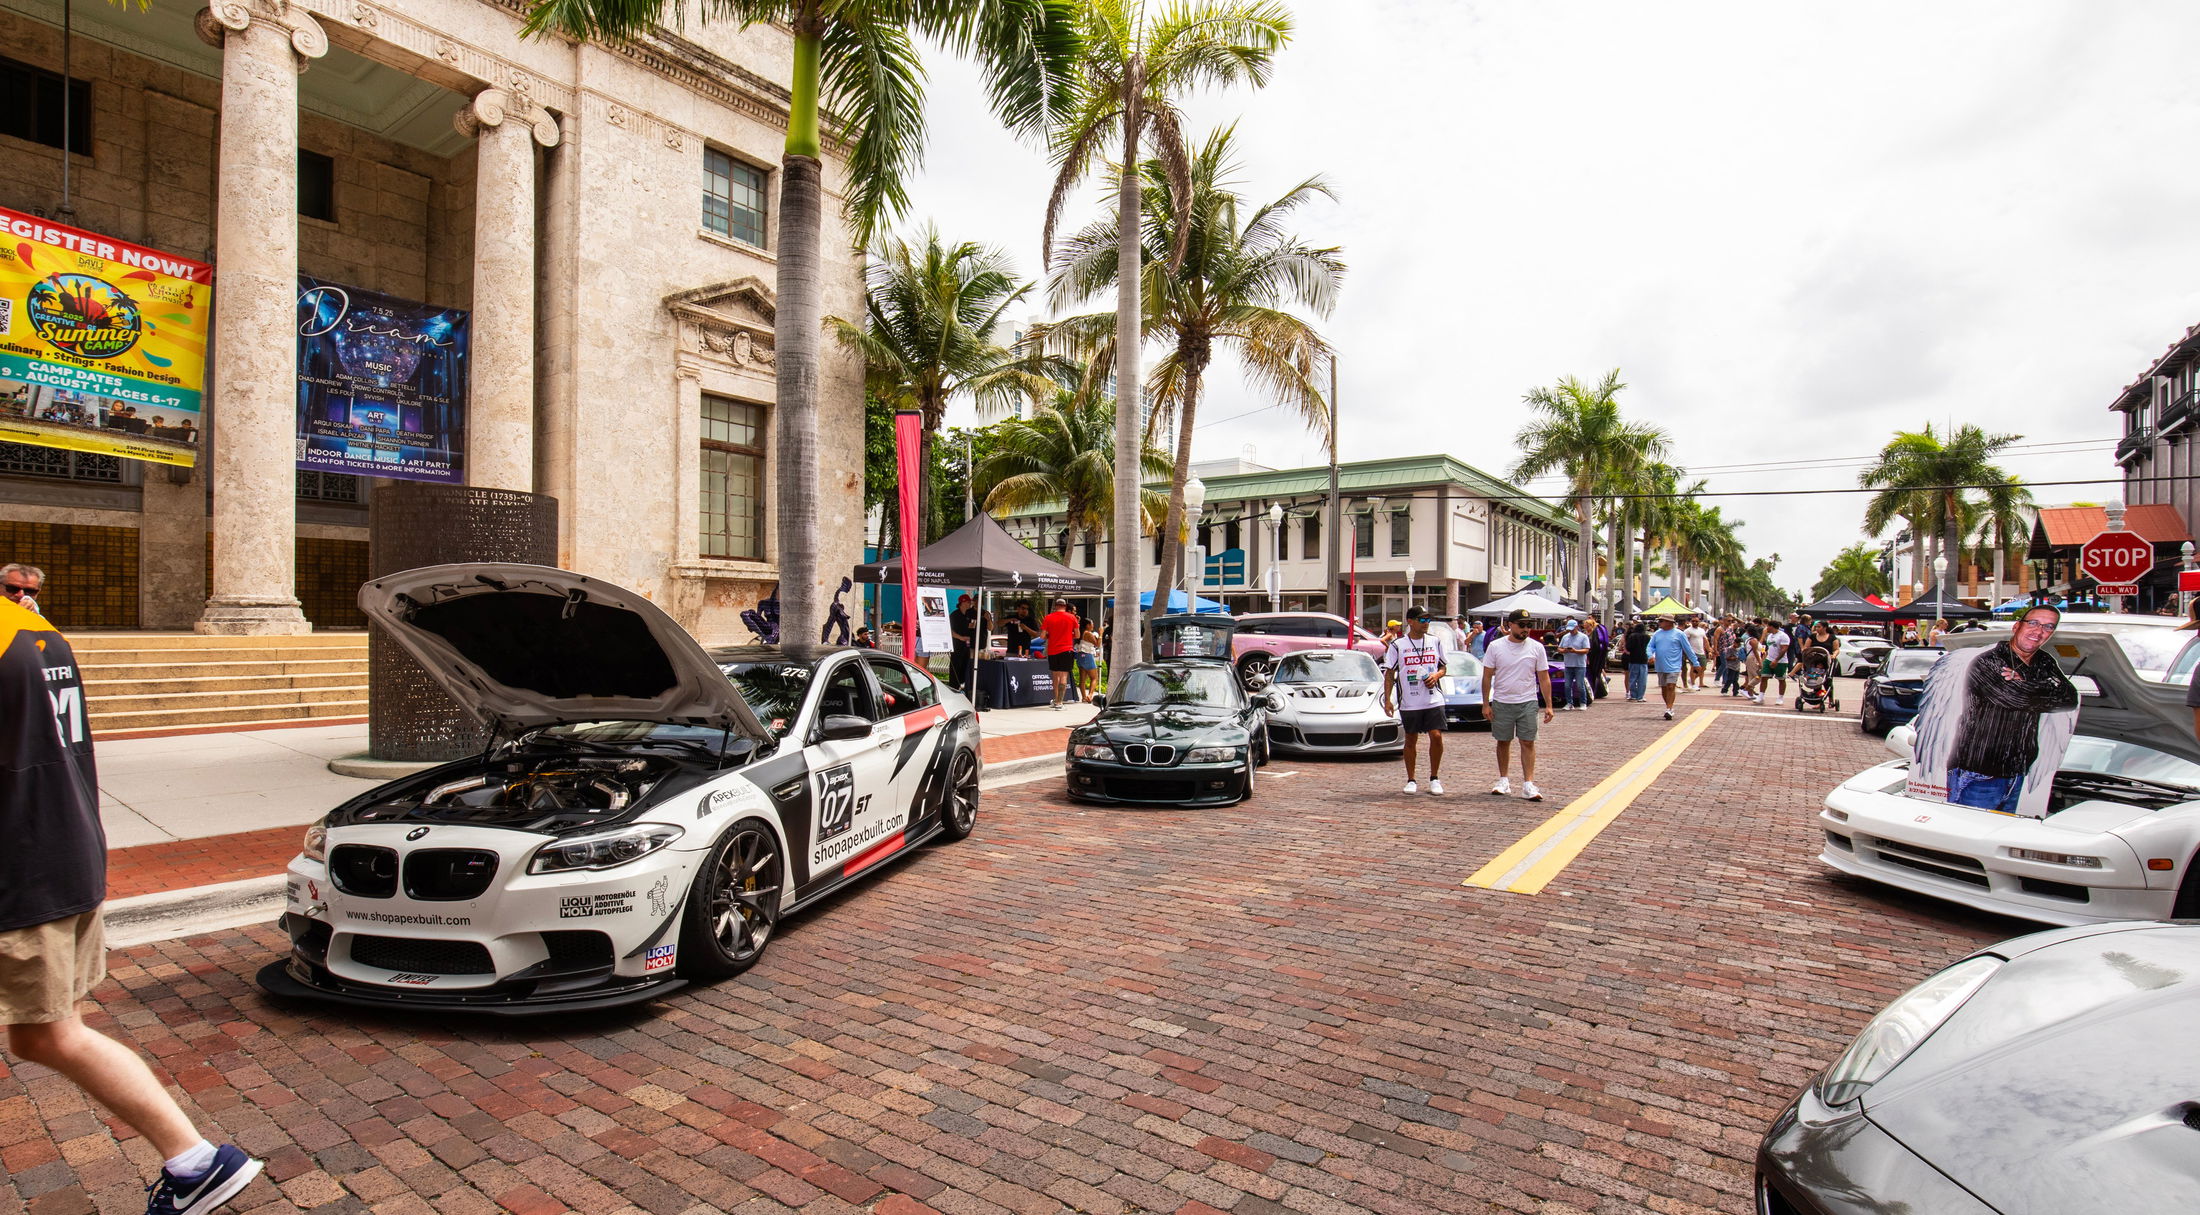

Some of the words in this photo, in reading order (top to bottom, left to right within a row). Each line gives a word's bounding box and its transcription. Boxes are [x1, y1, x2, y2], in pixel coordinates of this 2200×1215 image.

[122, 249, 194, 280] NOW!
[63, 312, 84, 321] 2025
[297, 286, 454, 346] Dream
[372, 306, 394, 317] 7.5.25
[34, 313, 75, 327] CREATIVE
[36, 322, 142, 341] Summer
[84, 341, 124, 350] CAMP
[54, 351, 95, 368] Strings
[104, 362, 144, 377] Fashion
[147, 371, 181, 384] Design
[365, 361, 392, 372] MUSIC
[28, 362, 73, 376] CAMP
[76, 370, 123, 387] DATES
[298, 374, 315, 383] CHAD
[316, 378, 343, 387] ANDREW
[336, 373, 353, 381] ADAM
[353, 376, 378, 385] COLLINS
[26, 371, 90, 390] AUGUST
[92, 384, 100, 392] 1
[112, 387, 149, 401] AGES
[151, 395, 181, 406] 6-17
[326, 387, 339, 395] LES
[367, 411, 385, 420] ART
[333, 421, 354, 430] OSKAR
[318, 428, 339, 437] ISRAEL
[396, 430, 415, 438] DEATH
[416, 431, 434, 440] PROOF
[348, 441, 374, 449] WHITNEY
[374, 443, 401, 452] HACKETT
[377, 436, 406, 445] SHANNON
[407, 439, 430, 447] TURNER
[308, 448, 342, 458] INDOOR
[344, 452, 372, 461] DANCE
[373, 456, 398, 465] MUSIC
[408, 458, 424, 467] ART
[425, 460, 451, 469] PARTY
[307, 456, 328, 465] SCAN
[329, 458, 345, 466] FOR
[346, 460, 375, 469] TICKETS
[382, 464, 403, 473] MORE
[404, 466, 451, 476] INFORMATION
[2086, 548, 2147, 568] STOP
[2118, 587, 2134, 595] WAY
[780, 666, 808, 678] 275
[829, 772, 849, 785] apex
[1914, 781, 1930, 789] Loving
[821, 785, 852, 829] 07
[854, 793, 873, 816] ST
[814, 813, 904, 865] shopapexbuilt.com
[561, 896, 591, 907] LIQUI
[594, 890, 636, 901] MOTORENÖLE
[594, 899, 625, 909] ADDITIVE
[561, 906, 592, 917] MOLY
[594, 905, 633, 916] AUTOPFLEGE
[346, 910, 471, 926] www.shopapexbuilt.com
[647, 944, 675, 960] LIQUI
[646, 955, 674, 970] MOLY
